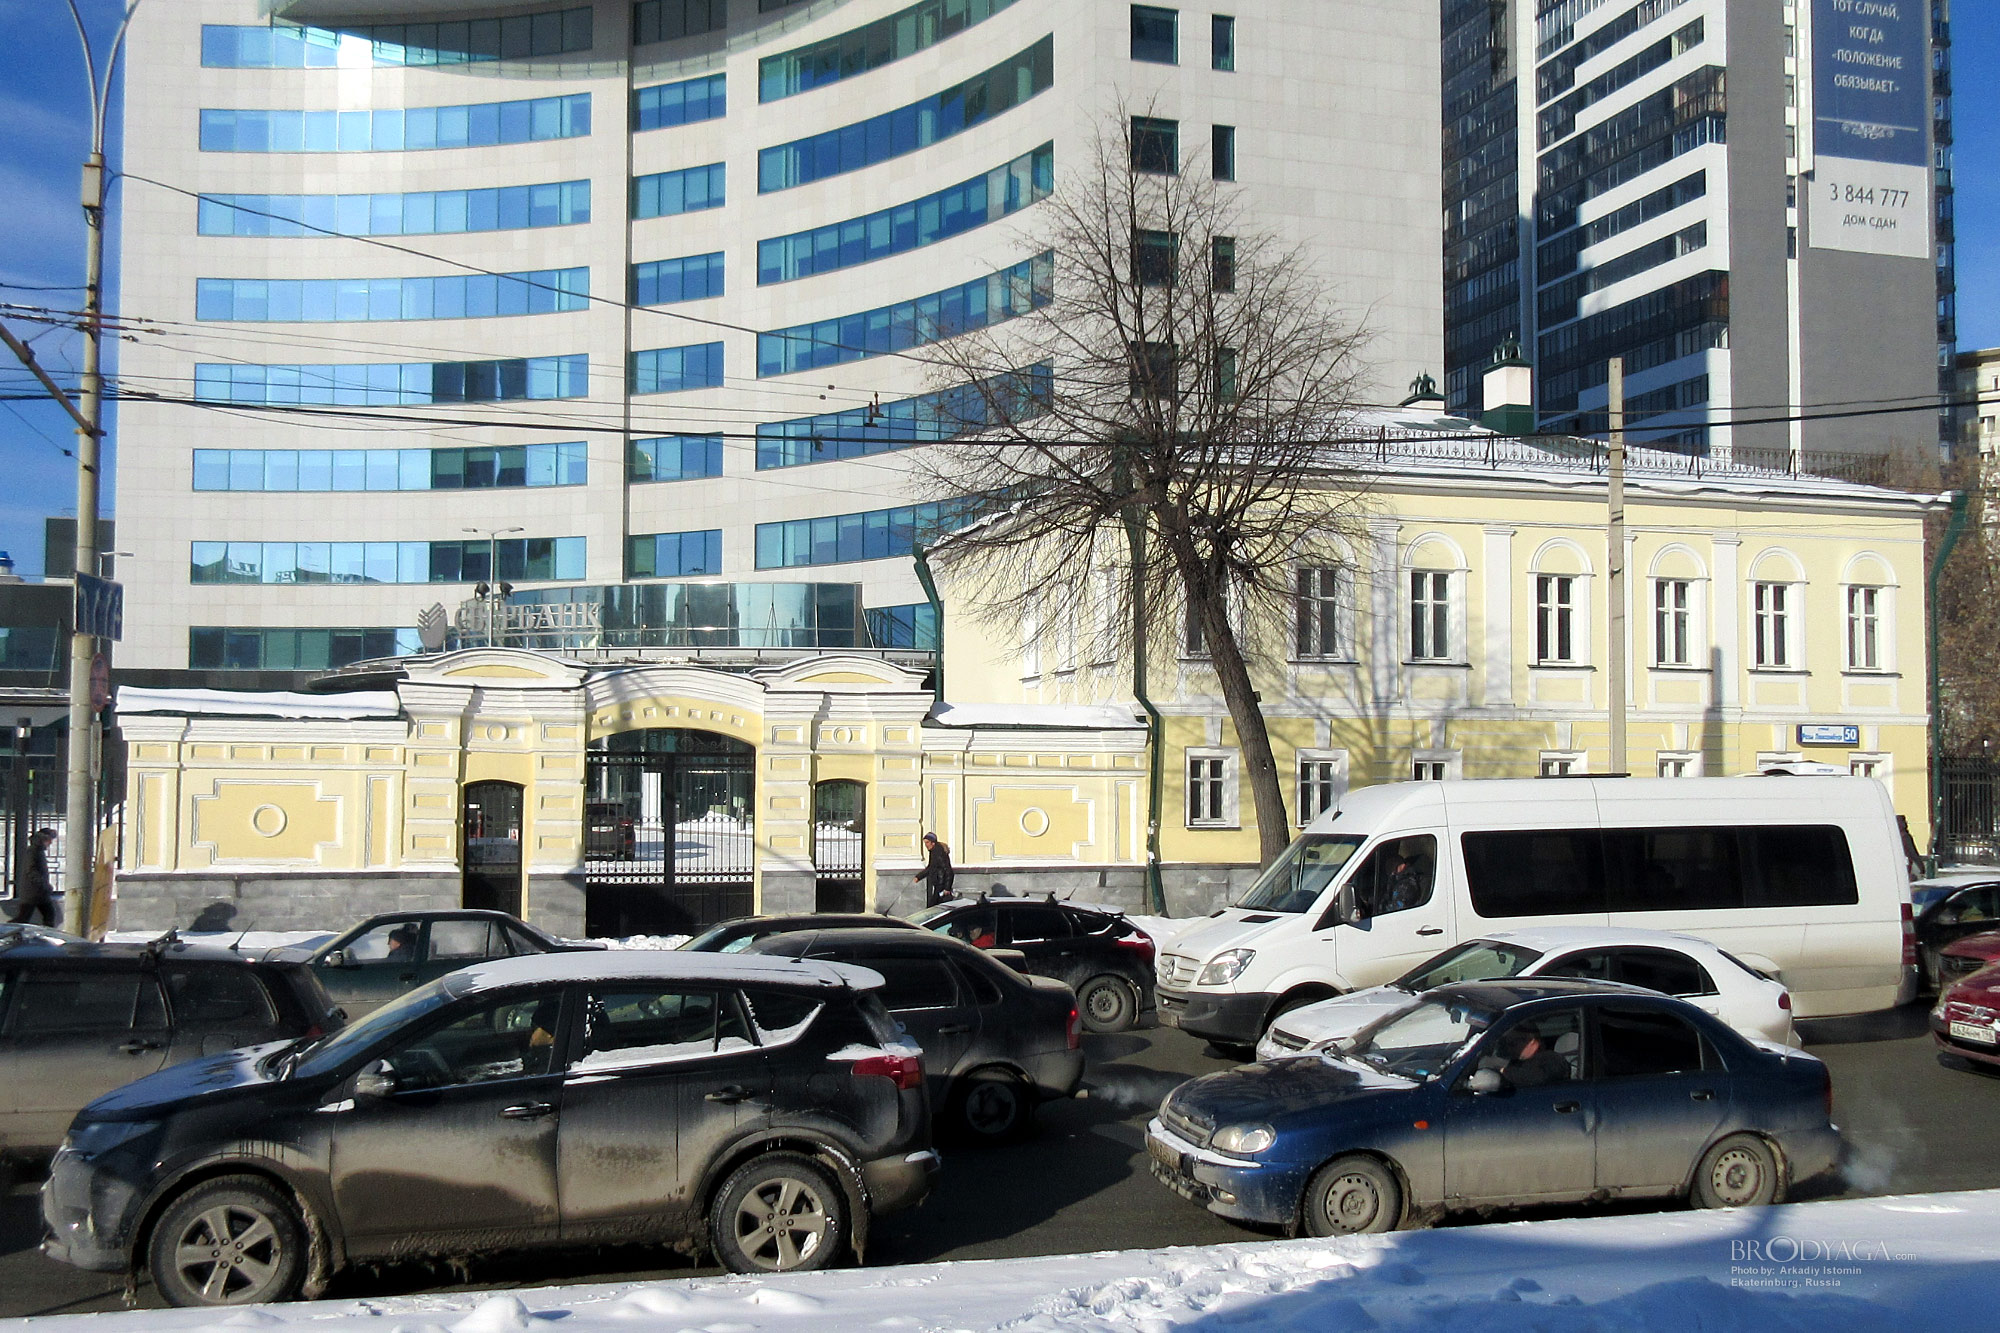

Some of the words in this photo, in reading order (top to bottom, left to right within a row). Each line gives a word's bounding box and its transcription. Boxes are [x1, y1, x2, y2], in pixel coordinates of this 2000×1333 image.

[1833, 0, 1852, 13] ТОТ
[1855, 2, 1900, 21] СЛУЧАЙ,
[1849, 26, 1884, 44] КОГДА
[1832, 49, 1904, 69] «ПОЛОЖЕНИЕ
[1834, 74, 1900, 93] ОБЯЗЫВАЕТ»
[1830, 183, 1839, 201] 3
[1845, 185, 1874, 205] 844
[1880, 188, 1909, 208] 777
[1843, 214, 1866, 227] ДОМ
[1869, 216, 1896, 230] СДАН
[1845, 728, 1856, 740] 50
